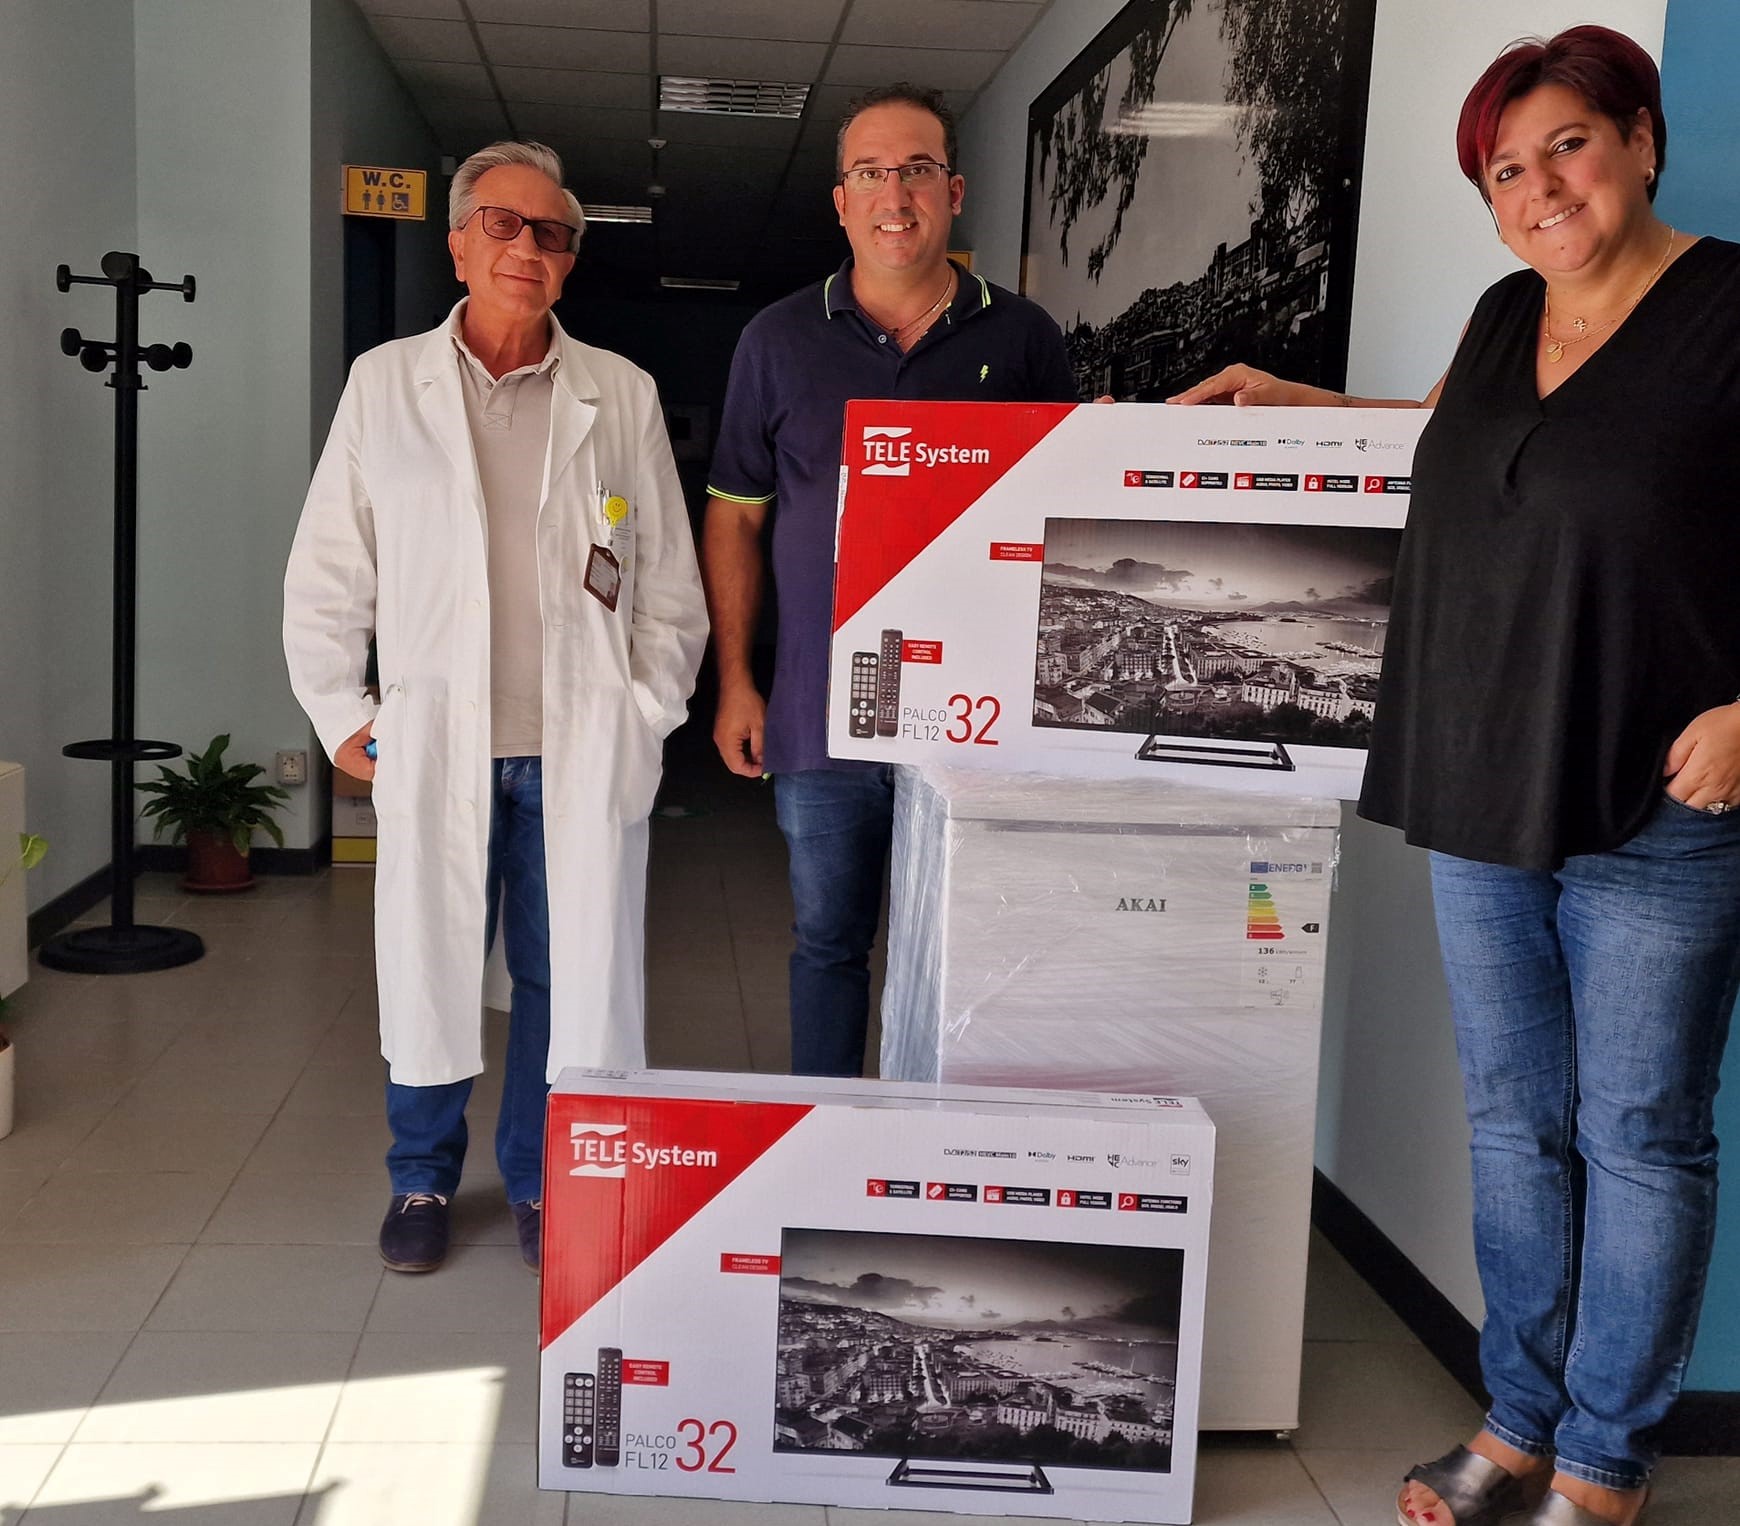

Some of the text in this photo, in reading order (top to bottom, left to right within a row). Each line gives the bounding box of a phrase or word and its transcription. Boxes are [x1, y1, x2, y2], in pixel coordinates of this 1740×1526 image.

[362, 170, 411, 189] W.C.
[1286, 439, 1305, 447] Dolby
[863, 441, 990, 468] TELE System
[903, 707, 947, 722] PALCO
[945, 693, 1001, 746] 32
[902, 723, 940, 741] FL12
[1115, 897, 1167, 912] AKAI
[1258, 947, 1275, 955] 136
[570, 1138, 718, 1170] TELE System
[1037, 1151, 1056, 1160] Dolby
[1172, 1157, 1189, 1168] sky
[625, 1433, 677, 1450] PALCO
[675, 1418, 738, 1474] 32
[625, 1451, 669, 1471] FL12
